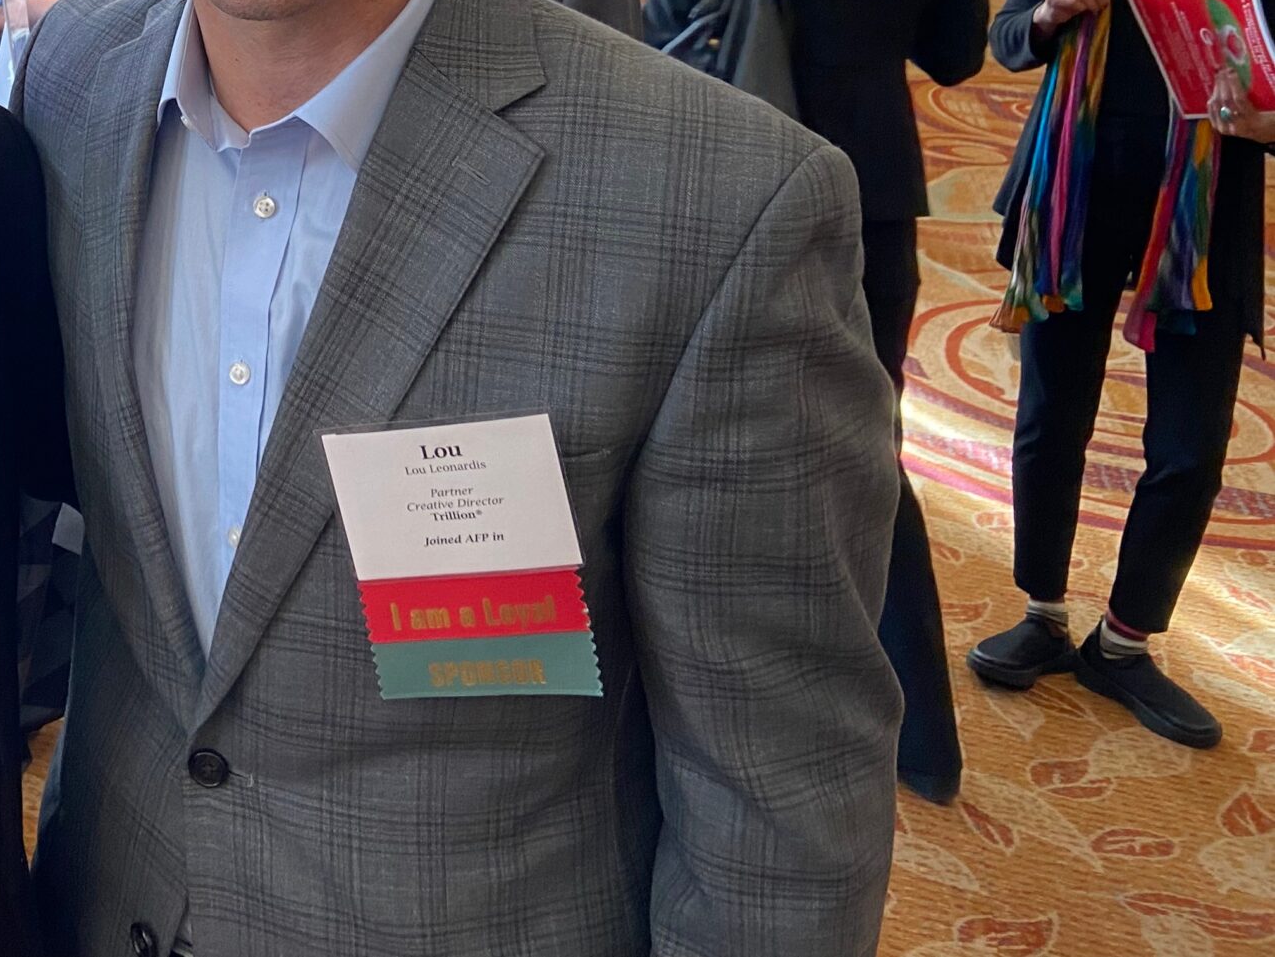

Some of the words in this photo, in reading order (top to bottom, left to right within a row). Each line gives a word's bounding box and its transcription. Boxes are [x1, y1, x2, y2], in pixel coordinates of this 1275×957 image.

[420, 444, 463, 460] Lou
[405, 465, 426, 476] Lou
[430, 460, 487, 474] Leonardis
[430, 487, 474, 498] Partner
[407, 500, 454, 512] Creative
[457, 496, 504, 509] Director
[424, 534, 462, 547] Joined
[465, 533, 489, 544] AFP
[492, 532, 504, 541] in
[390, 602, 402, 631] I
[410, 607, 451, 630] am
[459, 606, 475, 627] a
[429, 659, 547, 688] SPONSOR
